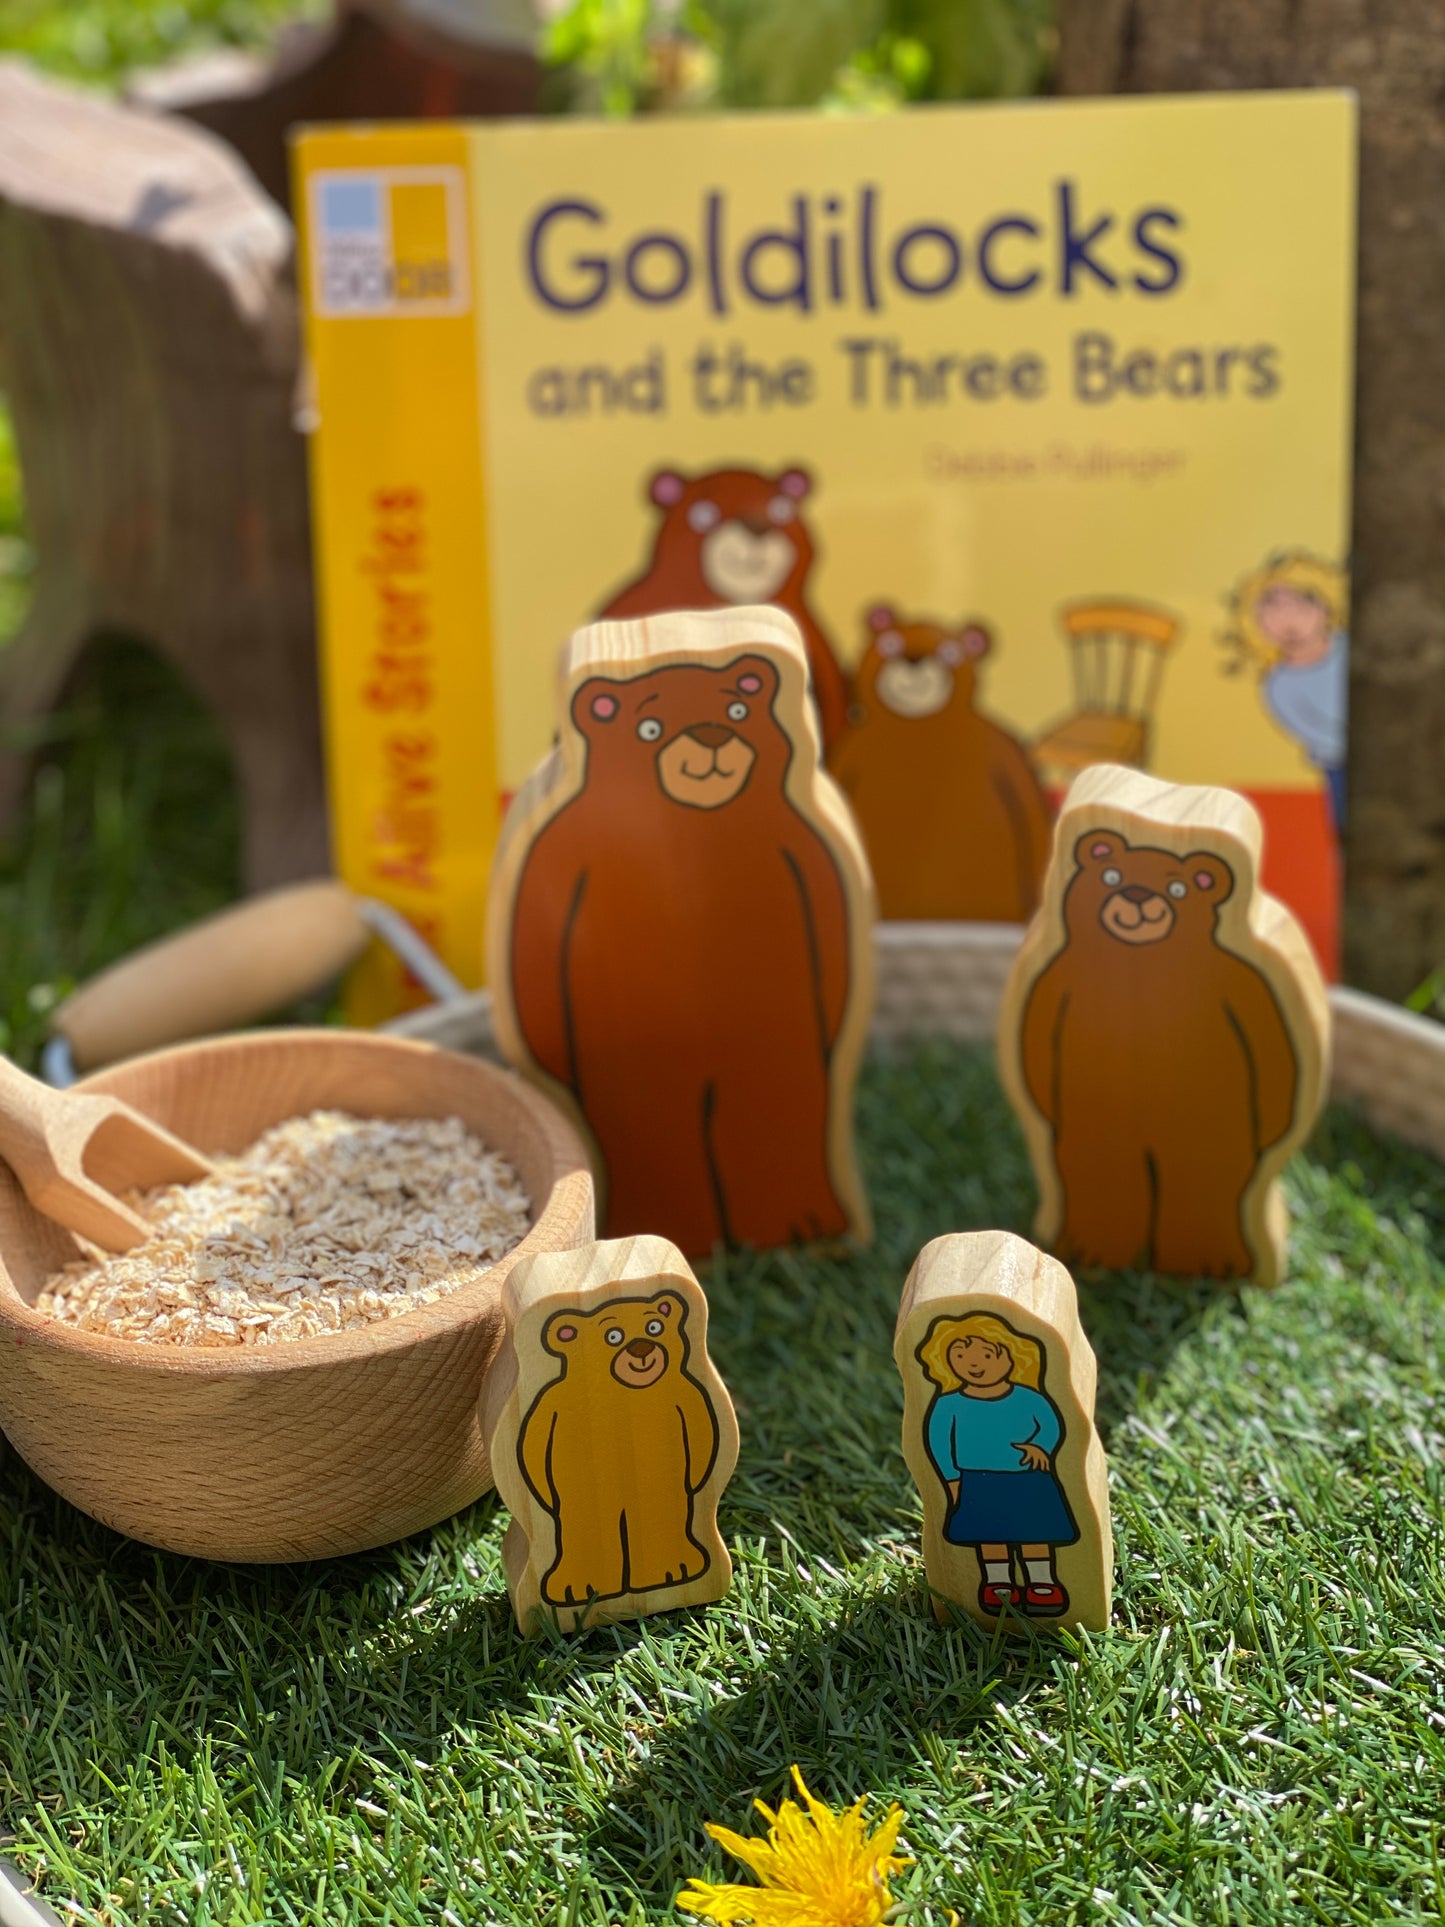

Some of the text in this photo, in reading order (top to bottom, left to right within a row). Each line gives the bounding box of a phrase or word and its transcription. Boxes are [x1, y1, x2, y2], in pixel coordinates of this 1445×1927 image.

[523, 180, 1184, 317] Goldilocks
[528, 331, 1281, 418] and the Three Bears
[363, 486, 435, 715] Stories
